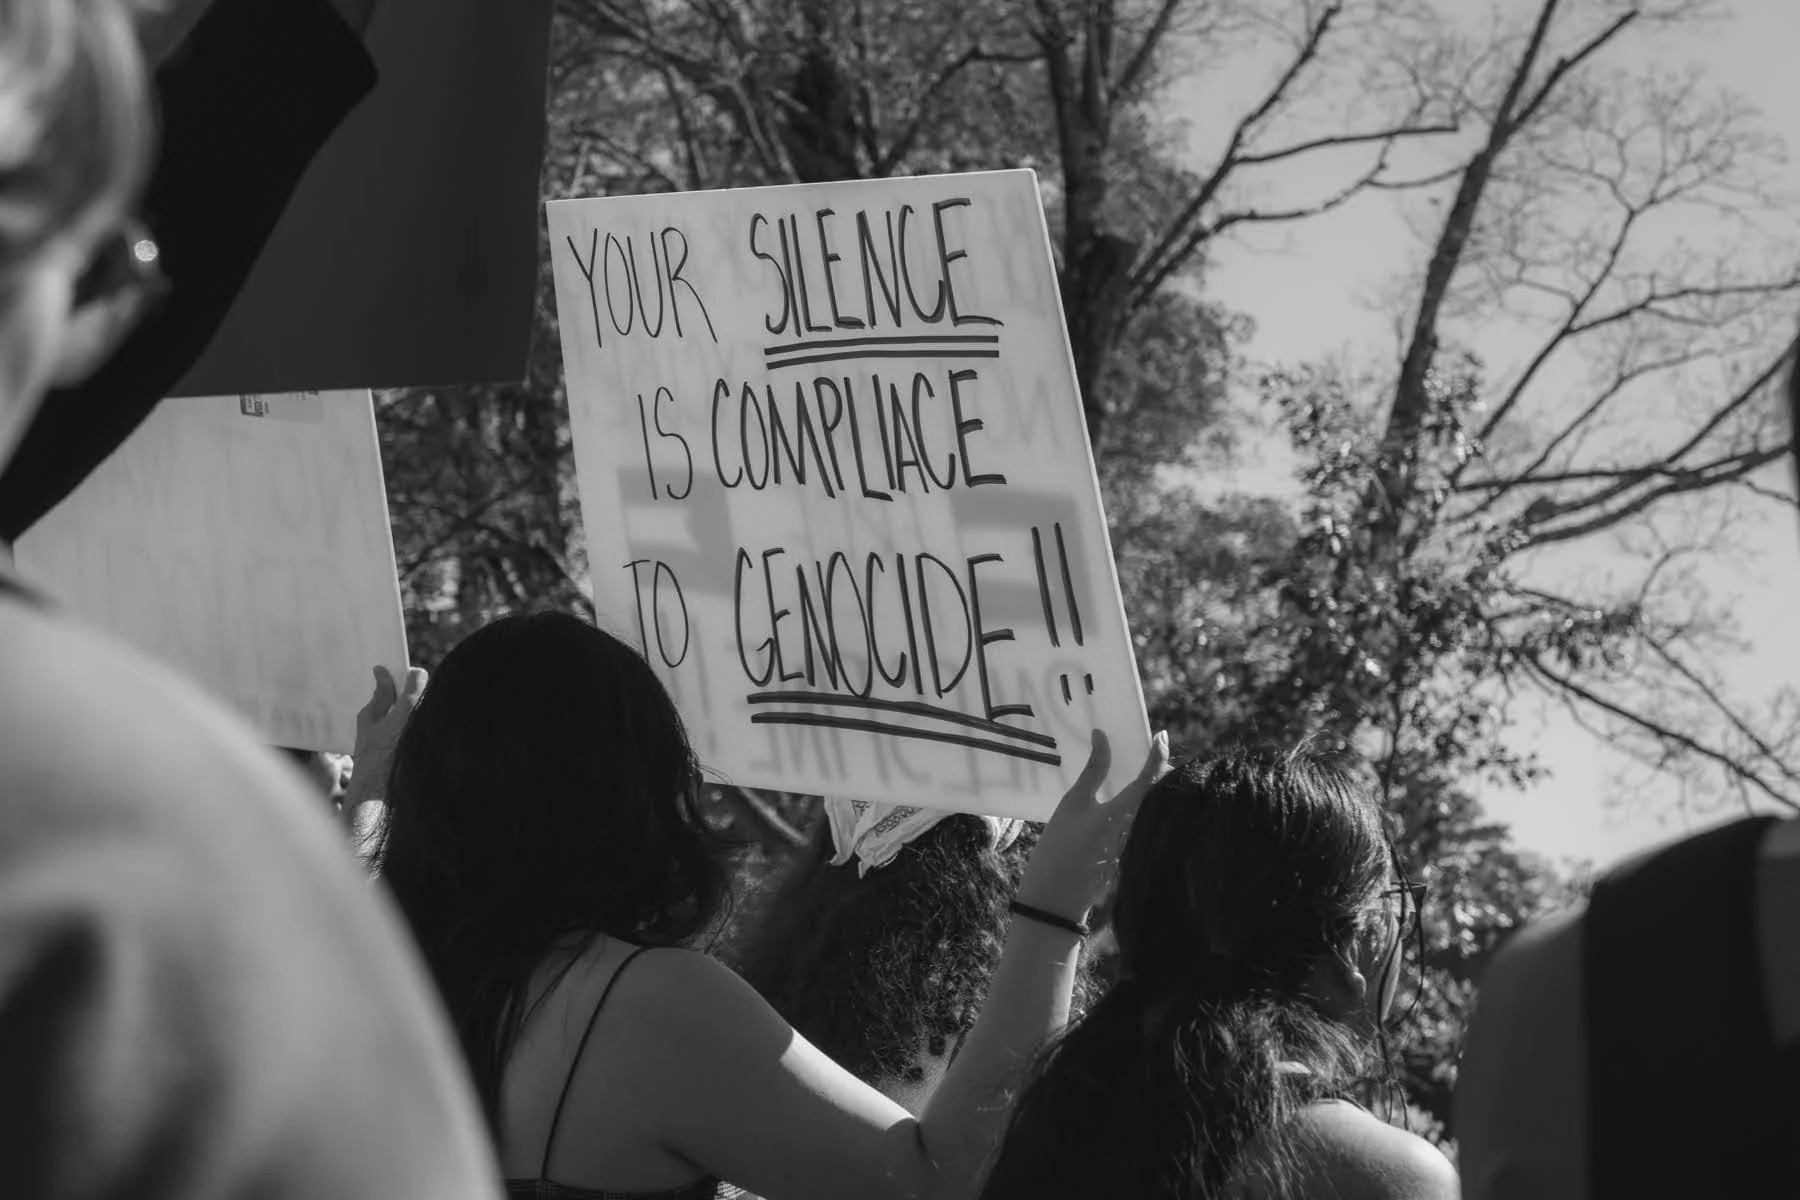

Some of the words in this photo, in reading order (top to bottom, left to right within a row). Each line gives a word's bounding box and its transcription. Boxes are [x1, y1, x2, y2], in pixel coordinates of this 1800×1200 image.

[566, 226, 718, 348] YOUR
[749, 197, 1003, 335] SILENCE
[637, 387, 693, 500] IS
[712, 369, 1006, 502] COMPLIACE
[624, 559, 689, 668] TO
